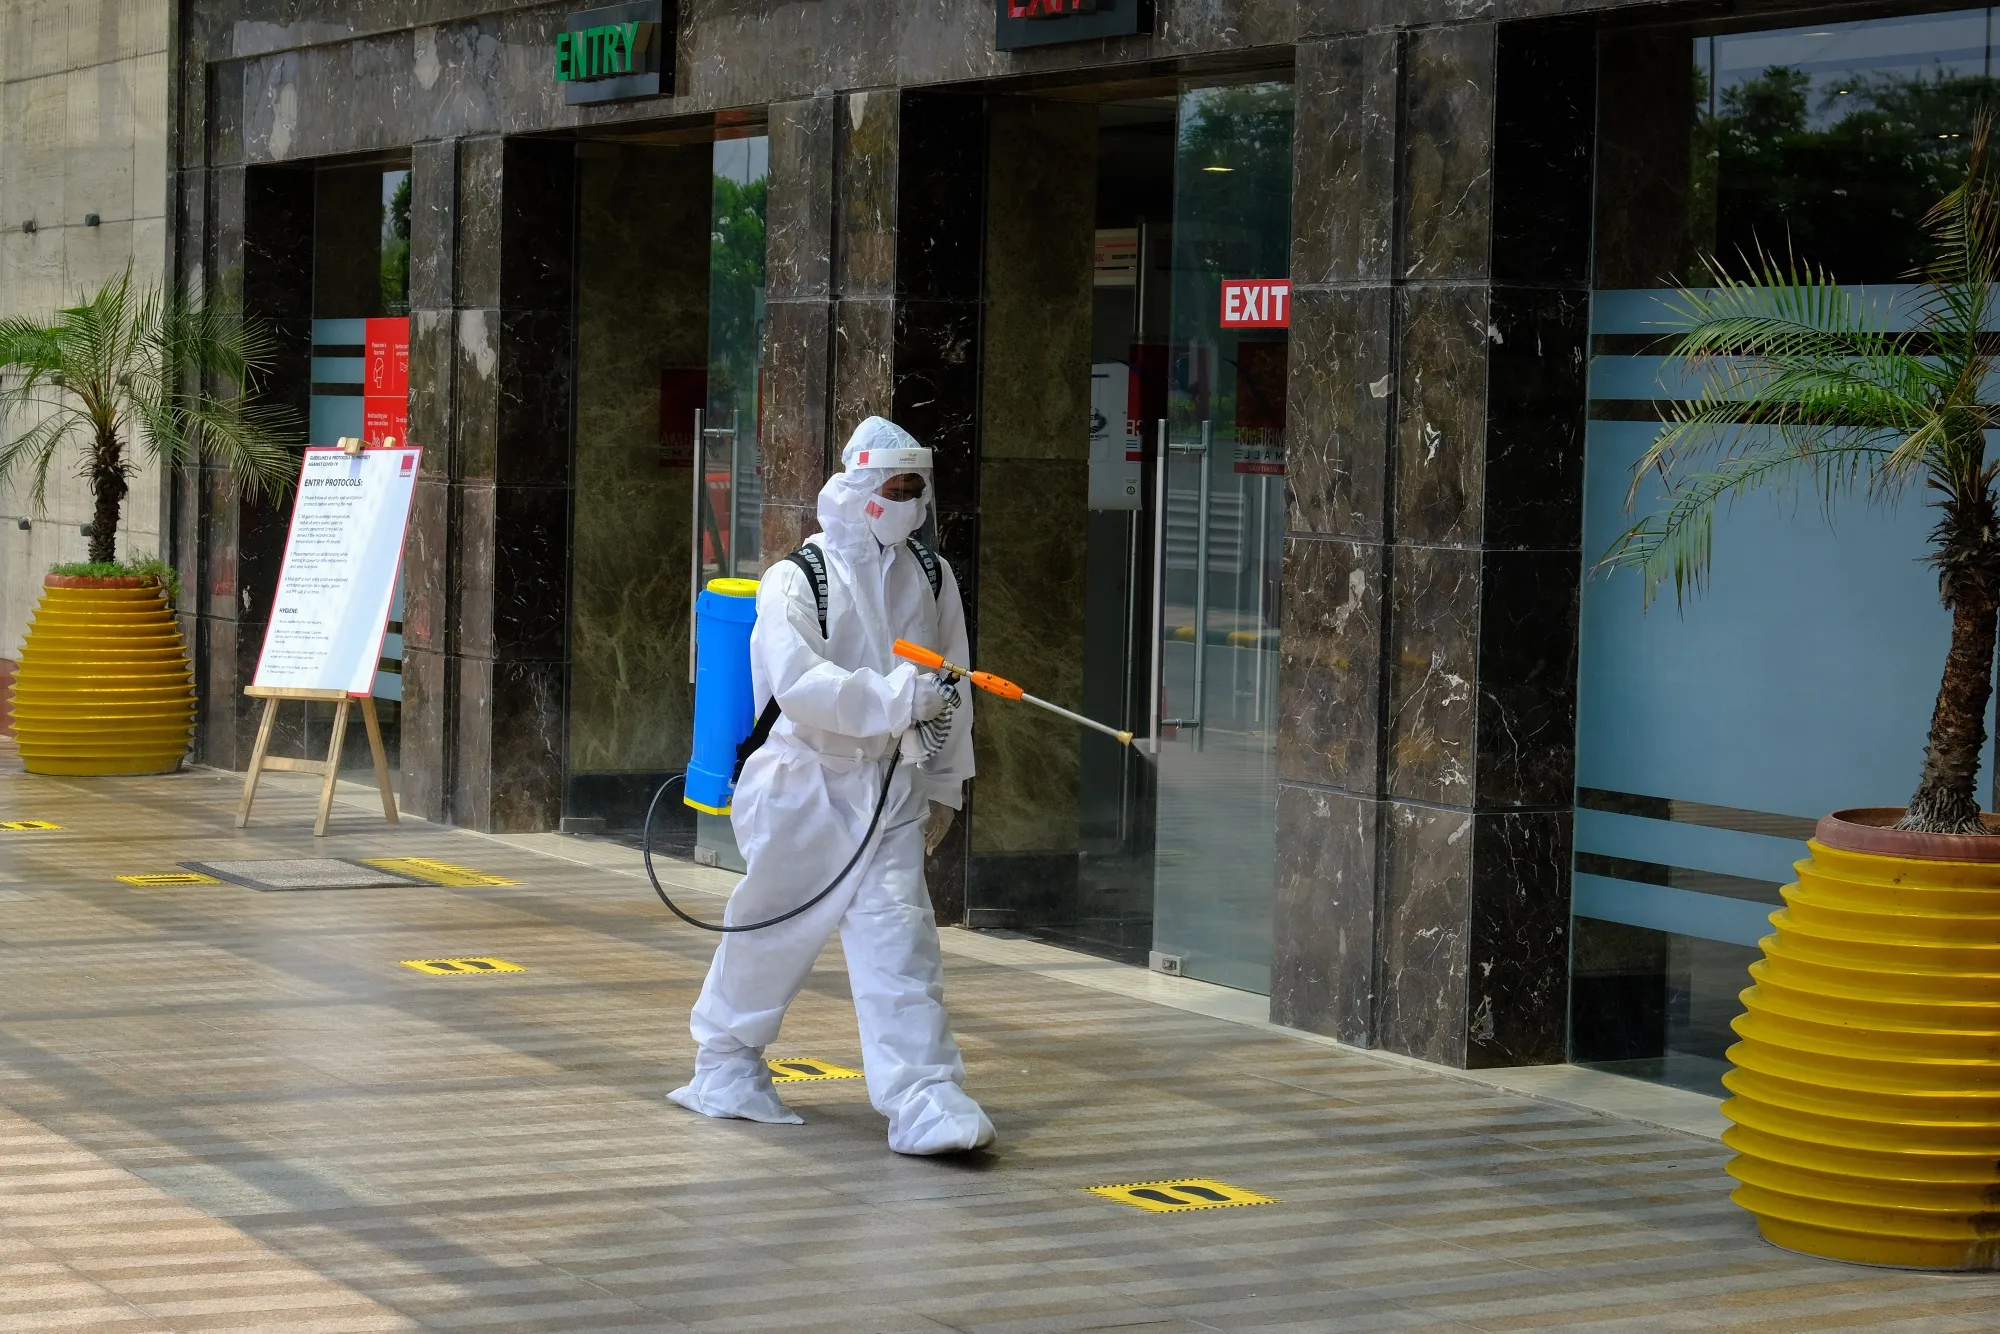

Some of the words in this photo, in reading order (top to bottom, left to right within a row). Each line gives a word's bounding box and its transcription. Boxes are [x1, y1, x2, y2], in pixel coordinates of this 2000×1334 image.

[556, 21, 640, 81] ENTRY
[1225, 286, 1288, 321] EXIT
[304, 479, 325, 487] ENTRY
[325, 479, 364, 487] PROTOCOLS:
[798, 548, 829, 621] SUNLORD
[911, 540, 938, 594] NLORD
